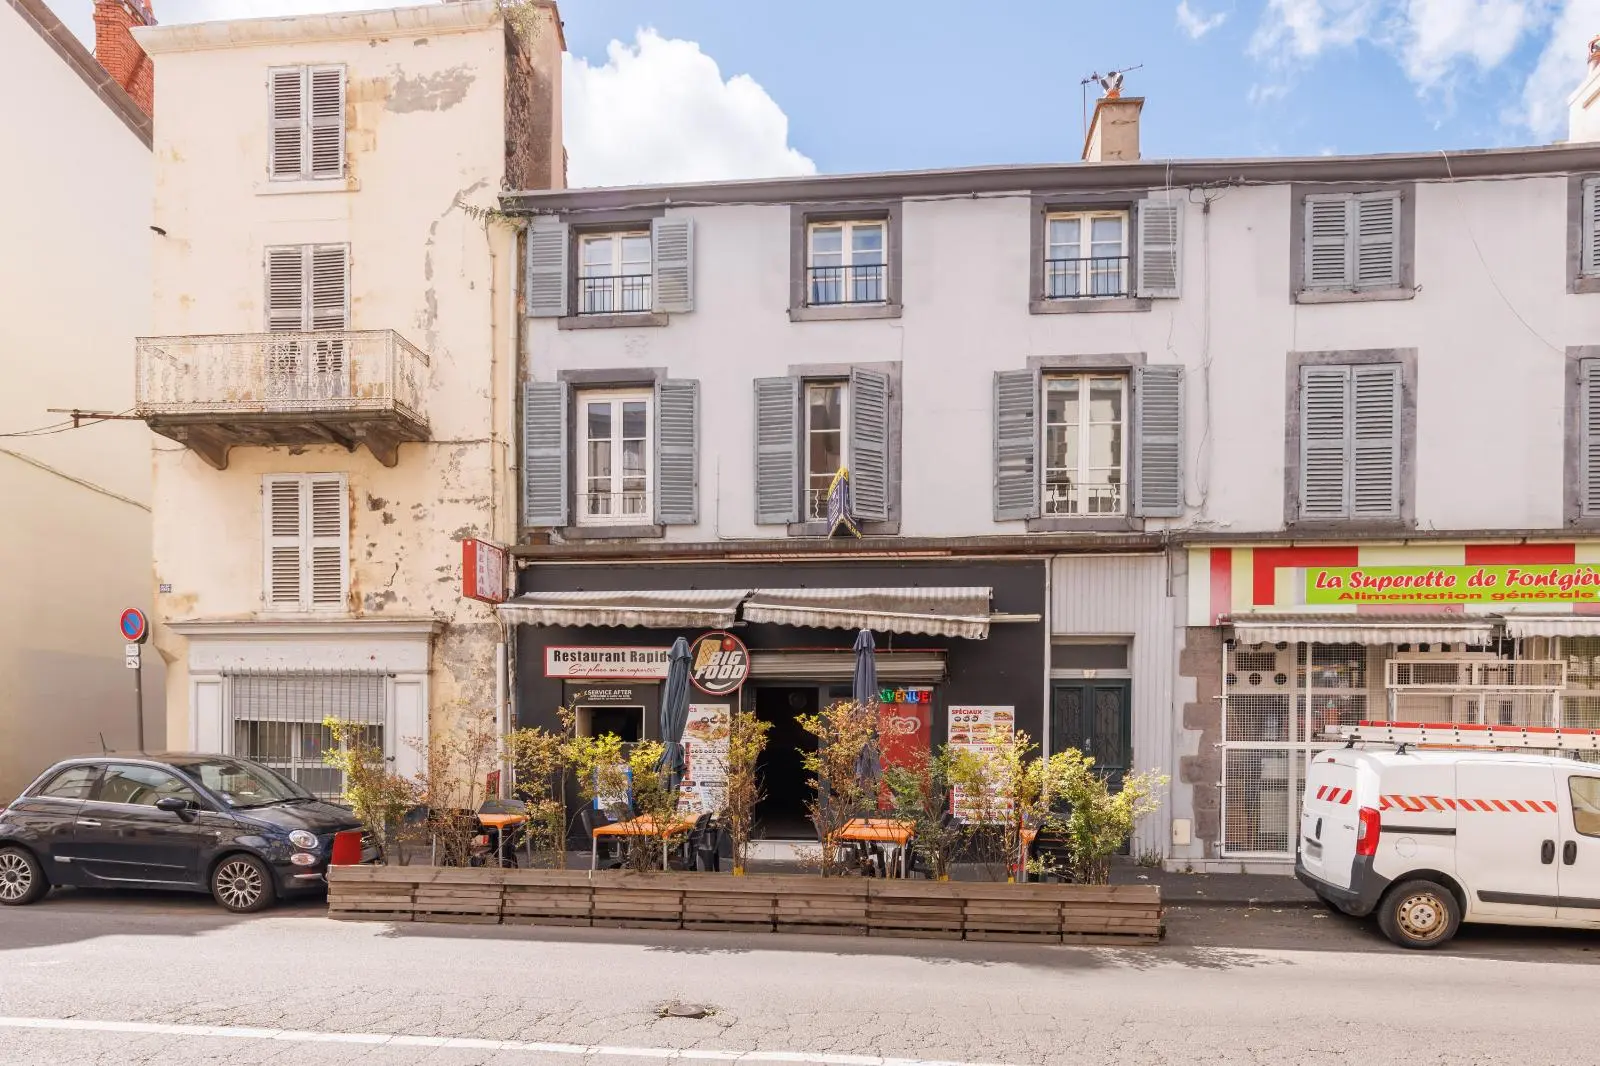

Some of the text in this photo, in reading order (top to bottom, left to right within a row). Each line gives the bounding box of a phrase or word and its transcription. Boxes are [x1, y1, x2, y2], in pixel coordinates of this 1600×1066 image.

[1316, 571, 1342, 588] La
[1349, 571, 1456, 592] Superette
[1467, 569, 1497, 587] de
[1338, 590, 1594, 601] Alimentation générale
[553, 650, 670, 663] Restaurant Rapid
[709, 650, 743, 665] BIG
[569, 663, 587, 675] Sur
[586, 663, 607, 677] place
[695, 664, 746, 680] FOOD
